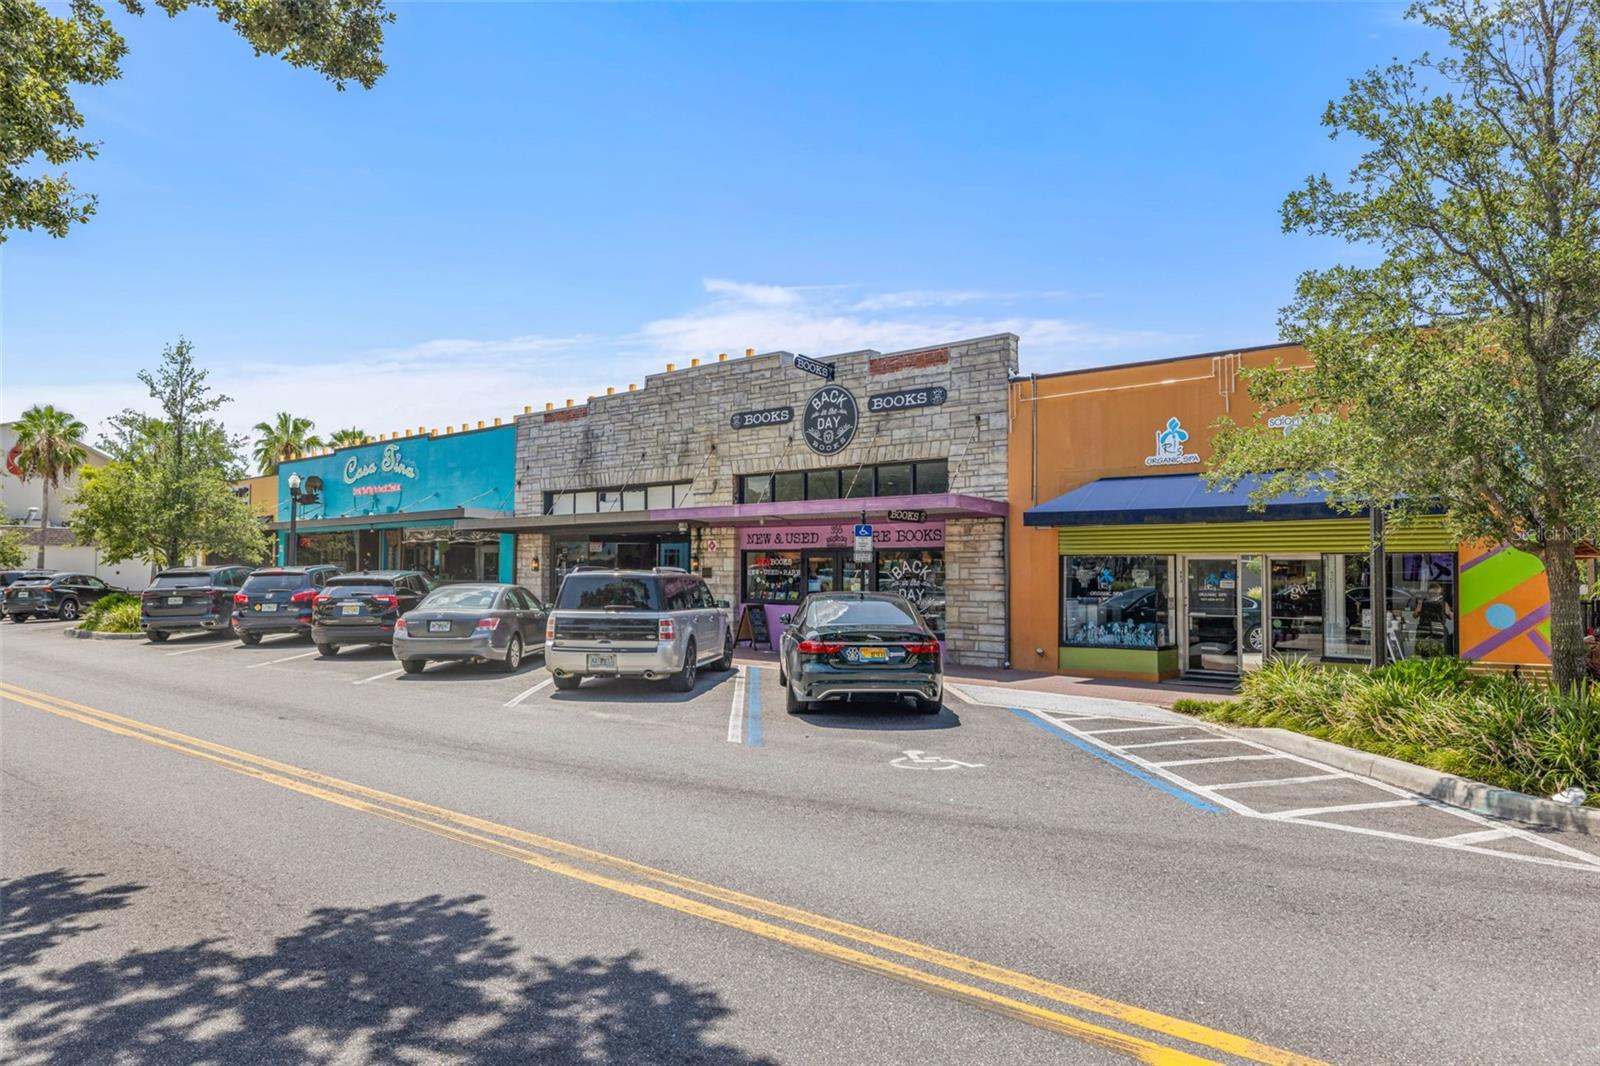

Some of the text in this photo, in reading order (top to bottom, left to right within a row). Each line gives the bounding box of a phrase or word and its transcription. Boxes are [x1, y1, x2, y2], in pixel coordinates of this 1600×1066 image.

[796, 358, 829, 377] BOOKS
[811, 390, 848, 410] BACK
[871, 392, 927, 410] BOOKS
[744, 410, 790, 426] BOOKS
[817, 416, 841, 430] DAY
[812, 437, 846, 452] BOOKS
[343, 444, 416, 485] Casa Tina
[1146, 455, 1199, 465] ORGANIC SPA
[890, 510, 920, 521] BOOKS
[746, 532, 820, 545] NEW & USED
[895, 529, 943, 543] BOOKS
[891, 560, 932, 580] BACK
[898, 588, 925, 601] DAY
